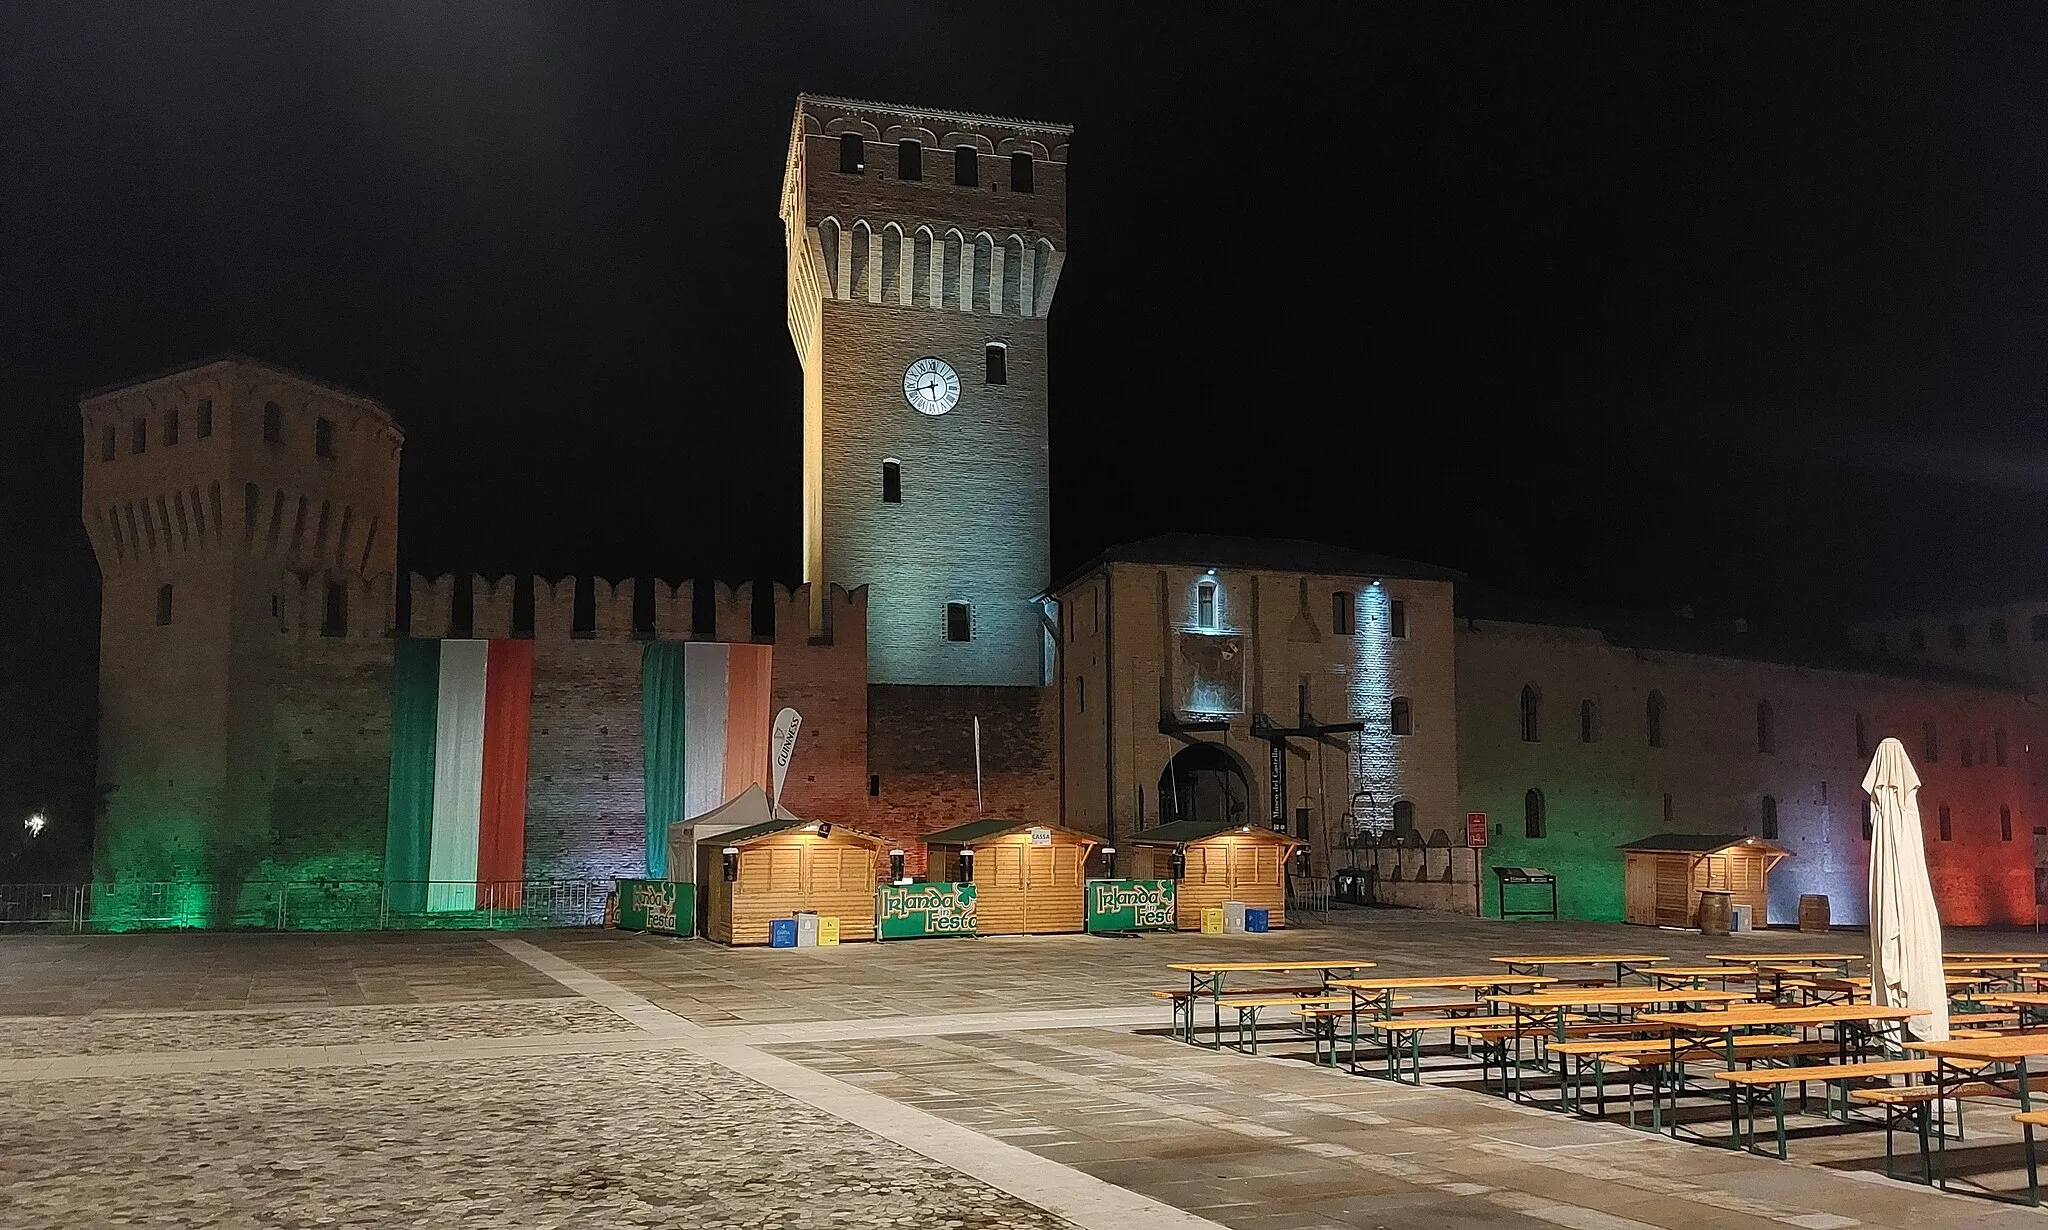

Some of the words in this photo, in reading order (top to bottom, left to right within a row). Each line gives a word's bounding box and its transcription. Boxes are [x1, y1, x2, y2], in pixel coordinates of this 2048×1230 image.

[777, 716, 799, 767] GUINNESS
[1271, 747, 1279, 778] Castello
[882, 888, 954, 918] Irlanda
[1097, 885, 1160, 913] Irlanda
[646, 906, 676, 929] Festa
[1135, 904, 1174, 925] Fest
